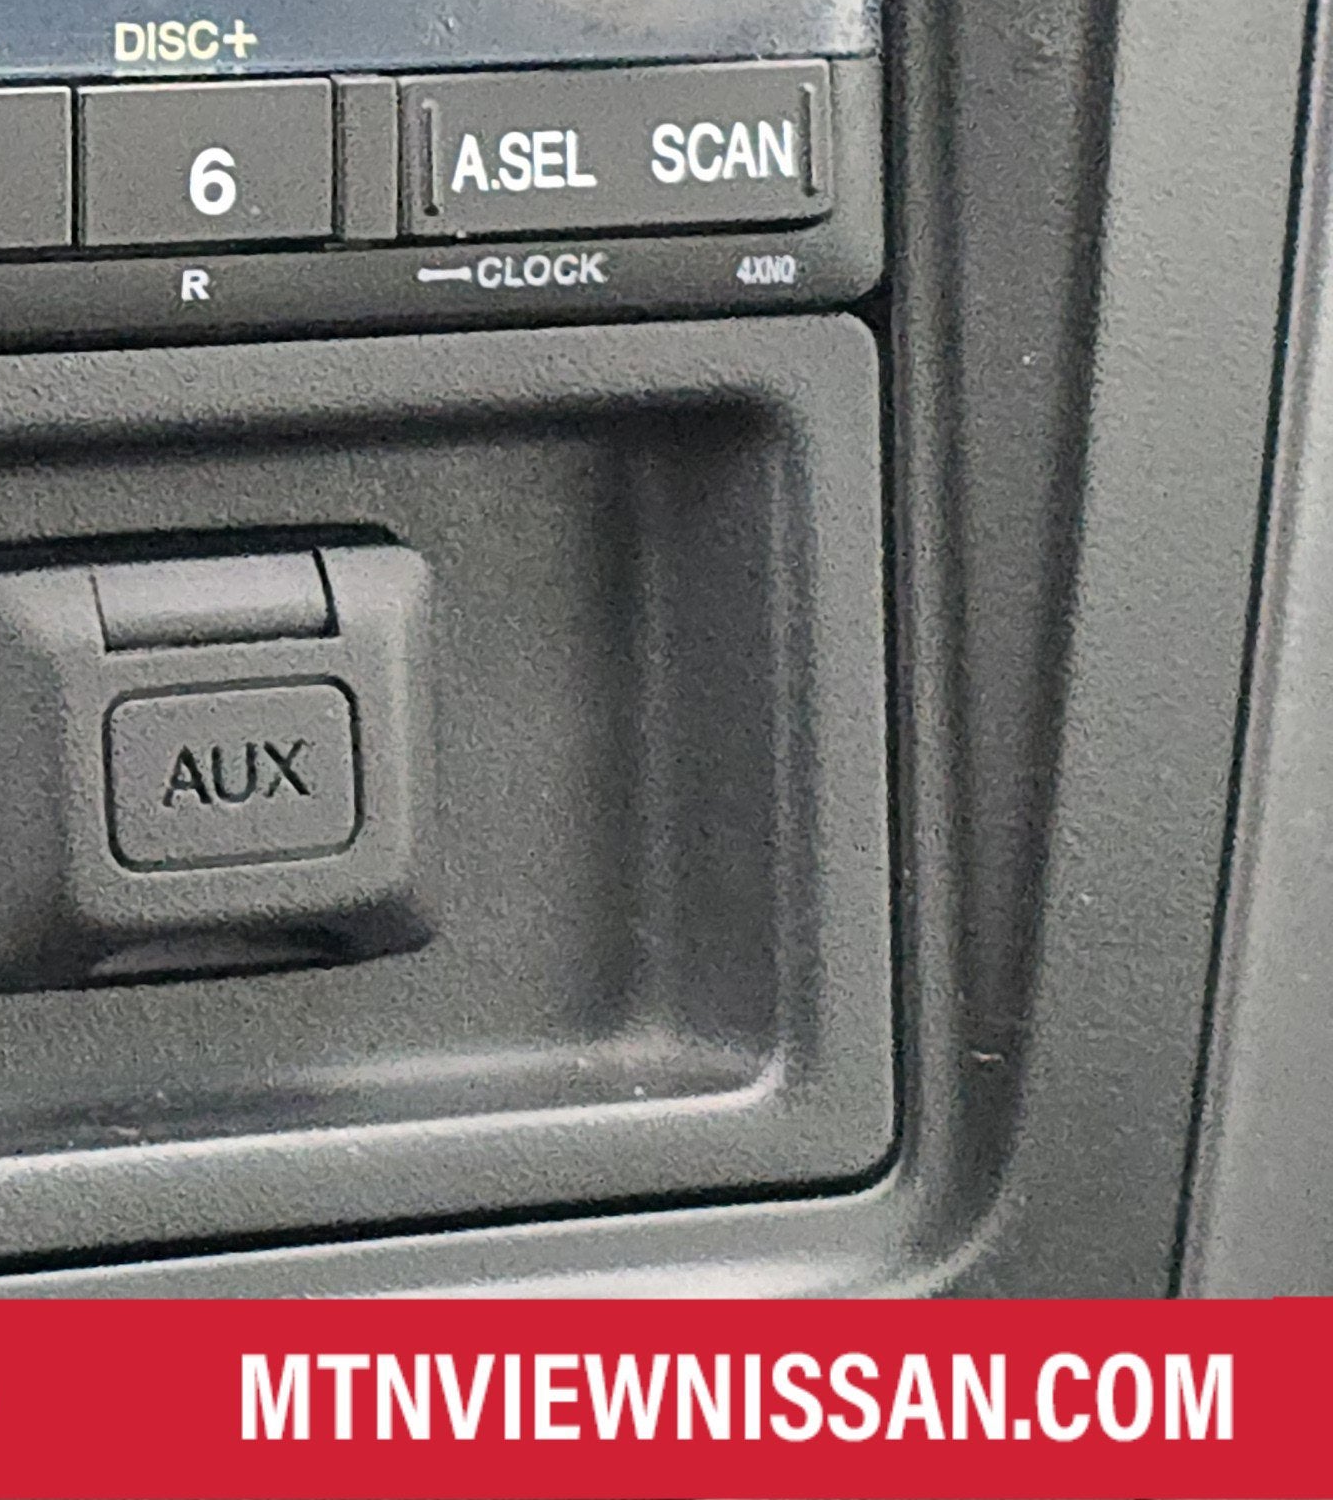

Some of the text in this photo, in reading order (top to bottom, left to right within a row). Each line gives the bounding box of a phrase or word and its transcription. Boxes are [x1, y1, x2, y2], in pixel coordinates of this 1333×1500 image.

[189, 147, 237, 216] 6
[451, 119, 797, 193] A.SEL SCAN
[181, 269, 210, 301] R
[477, 252, 608, 288] CLOCK
[161, 738, 312, 806] AUX
